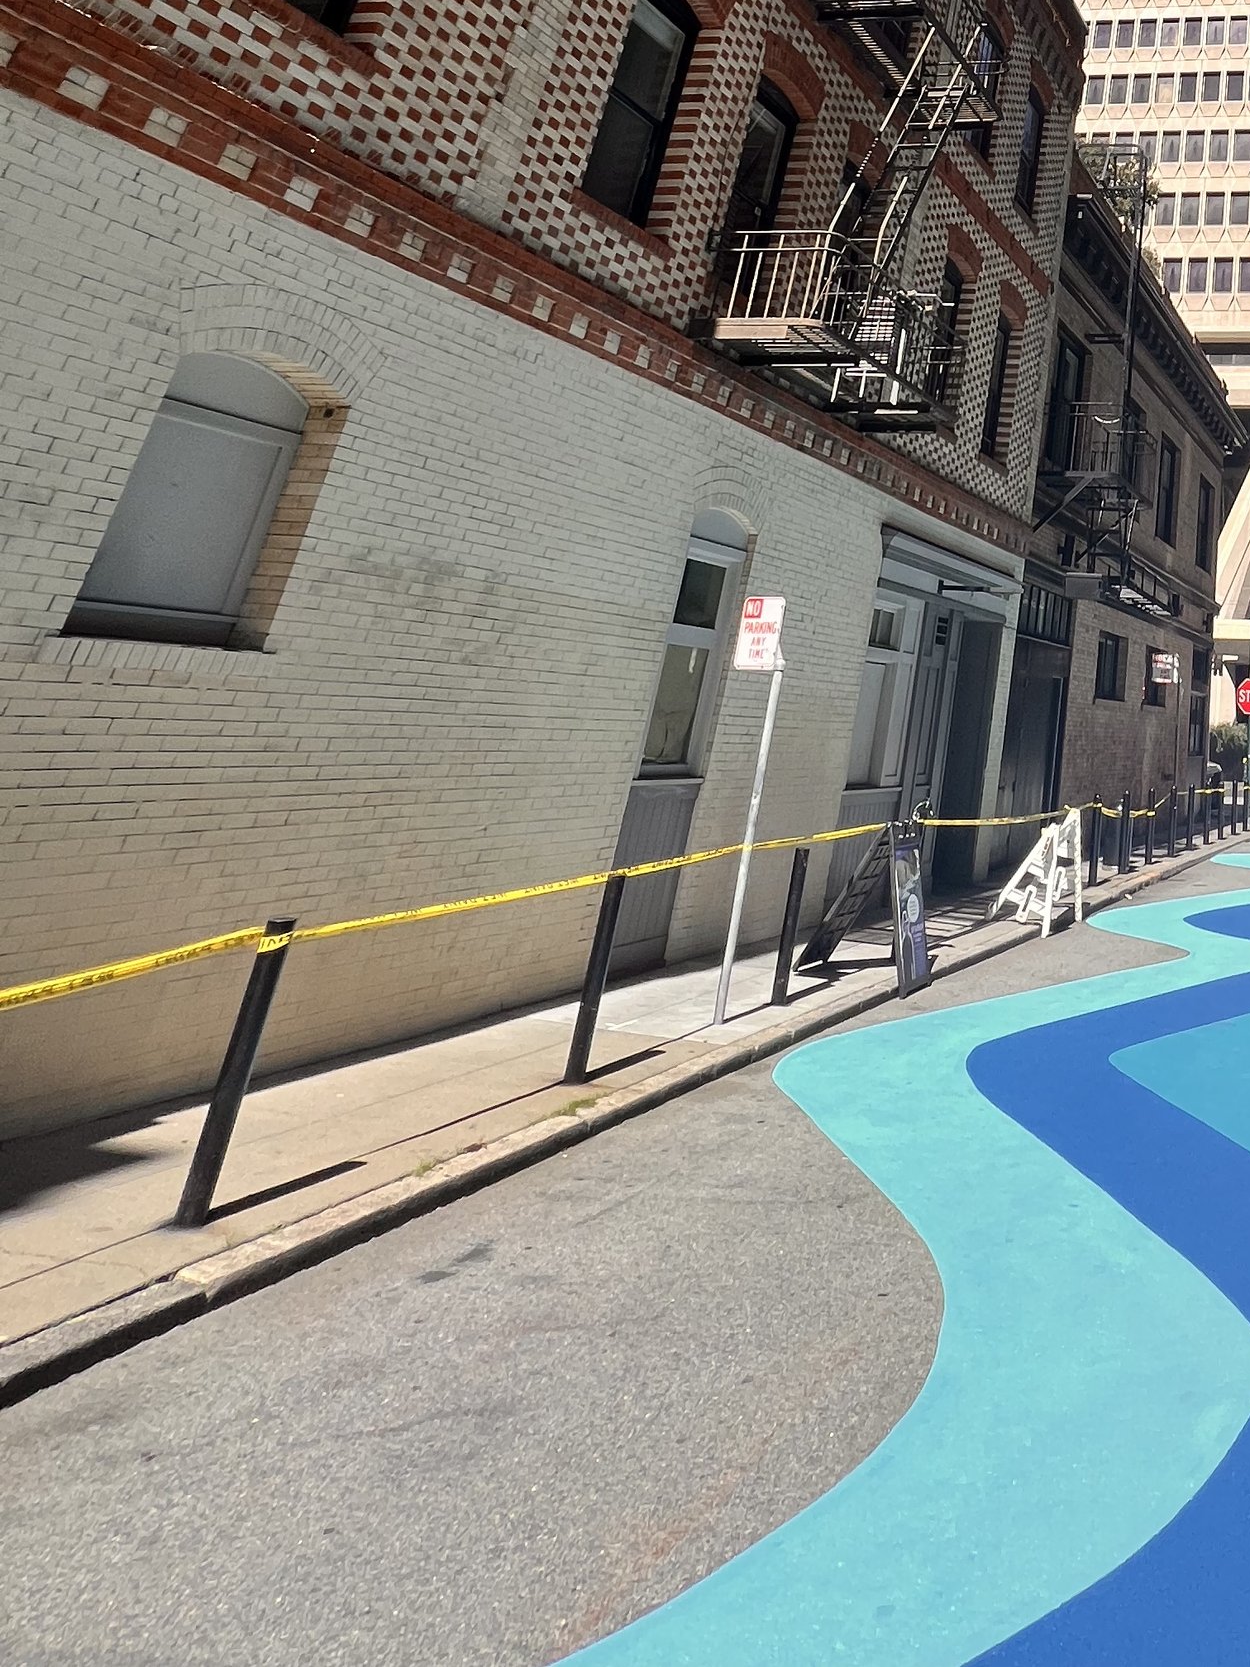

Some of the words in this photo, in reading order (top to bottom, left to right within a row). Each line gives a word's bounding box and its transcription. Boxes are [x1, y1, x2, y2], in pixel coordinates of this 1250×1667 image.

[745, 599, 762, 617] NO
[744, 621, 778, 635] PARKING
[750, 637, 767, 647] ANY
[748, 648, 765, 660] TIME
